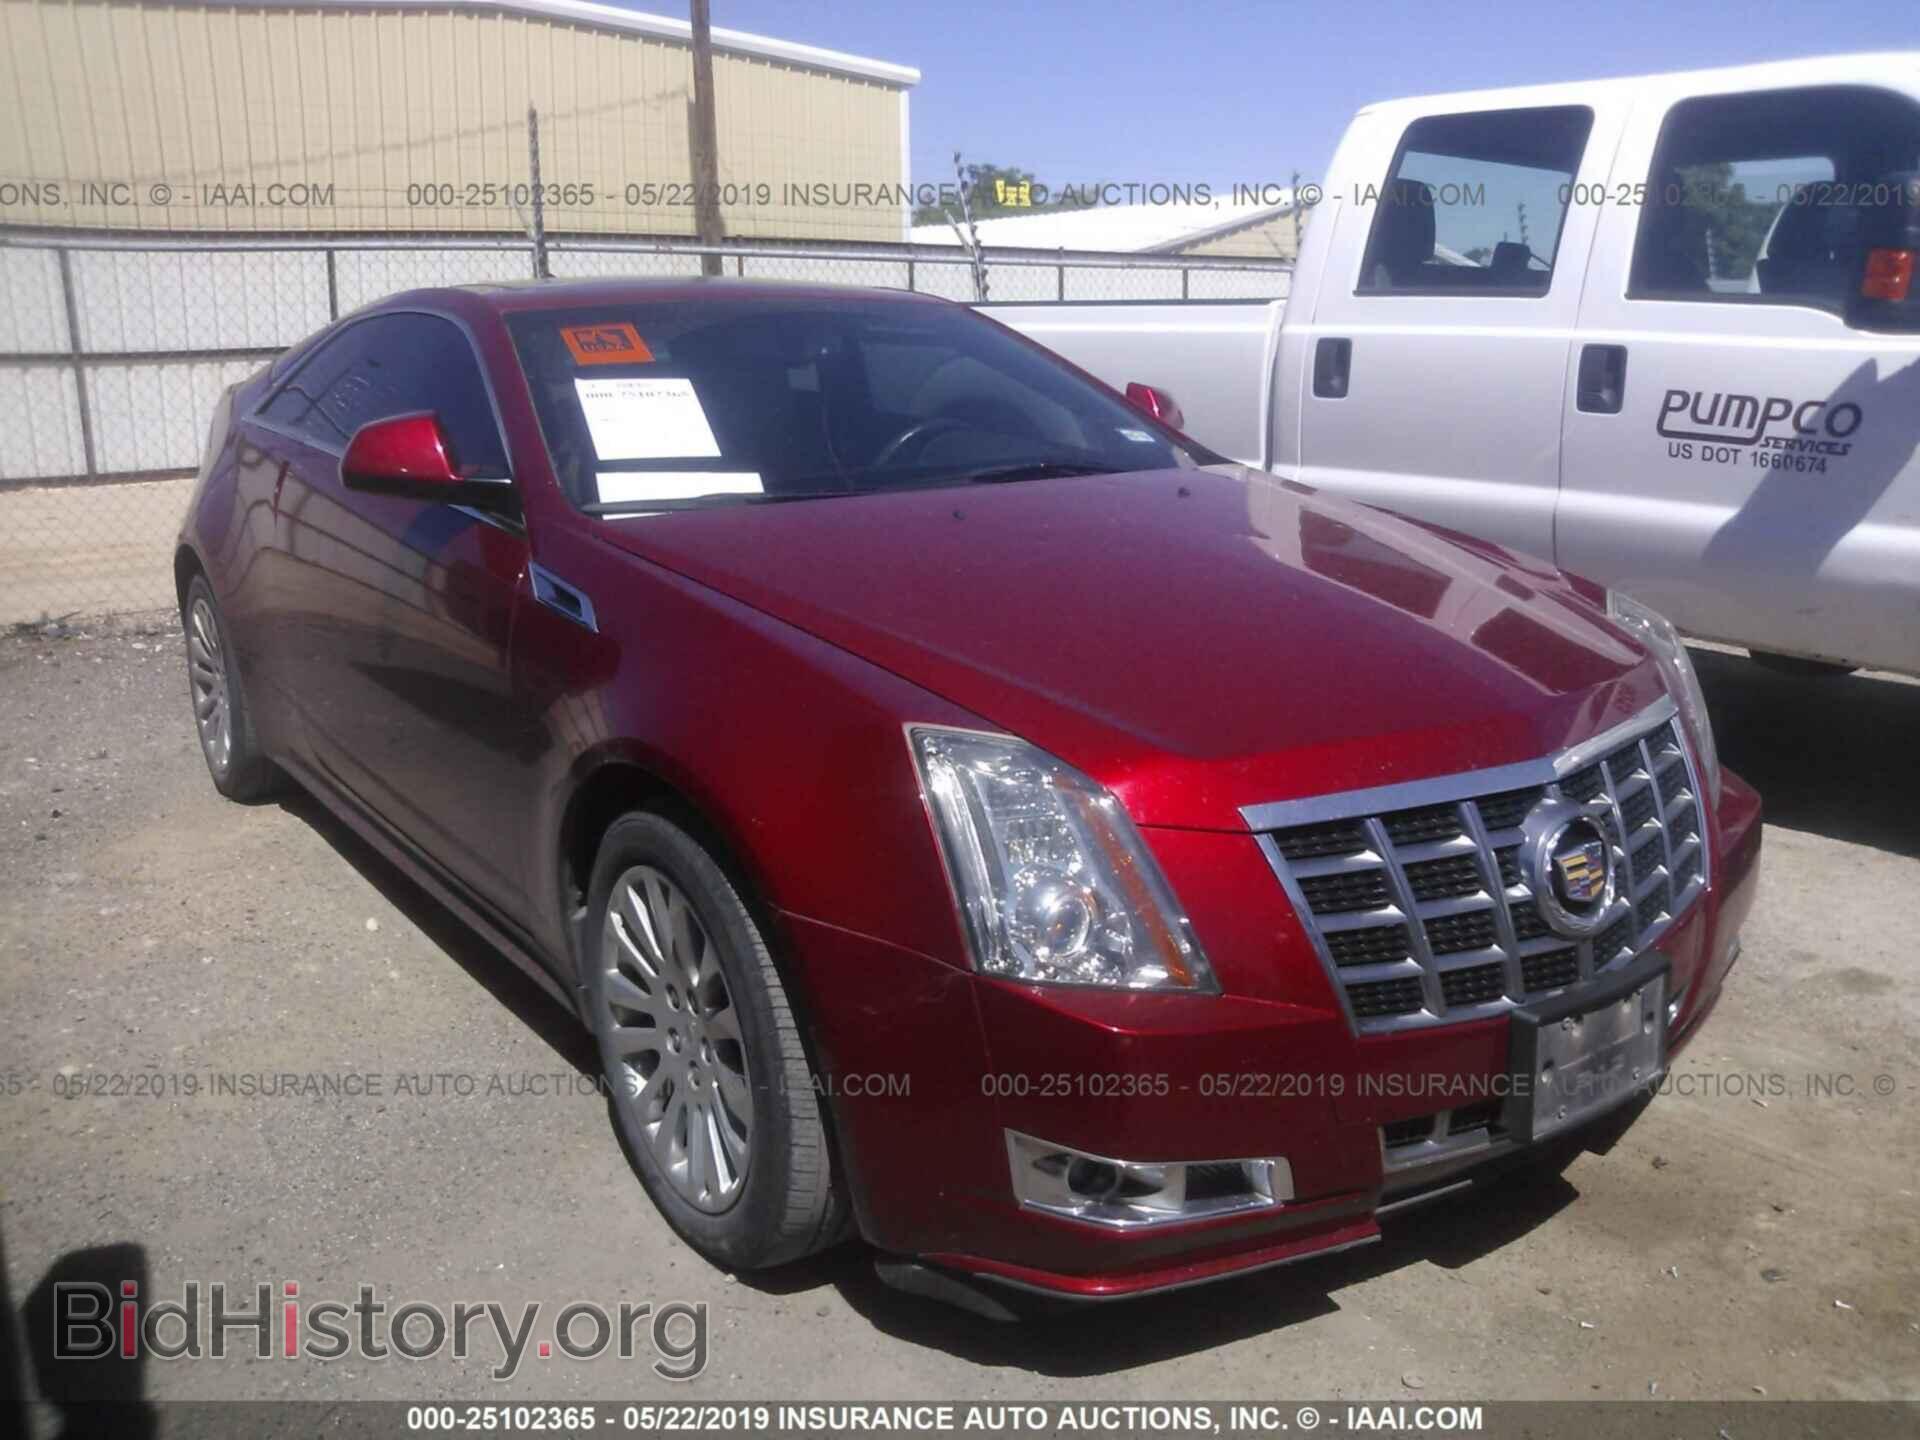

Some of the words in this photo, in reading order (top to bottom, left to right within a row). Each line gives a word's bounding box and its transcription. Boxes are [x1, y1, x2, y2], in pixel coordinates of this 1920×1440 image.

[1656, 389, 1863, 446] PUMPCO
[1667, 441, 1693, 460] US
[1701, 446, 1742, 465] DOT
[1750, 451, 1828, 474] 1660674
[1759, 436, 1853, 457] SERVICES
